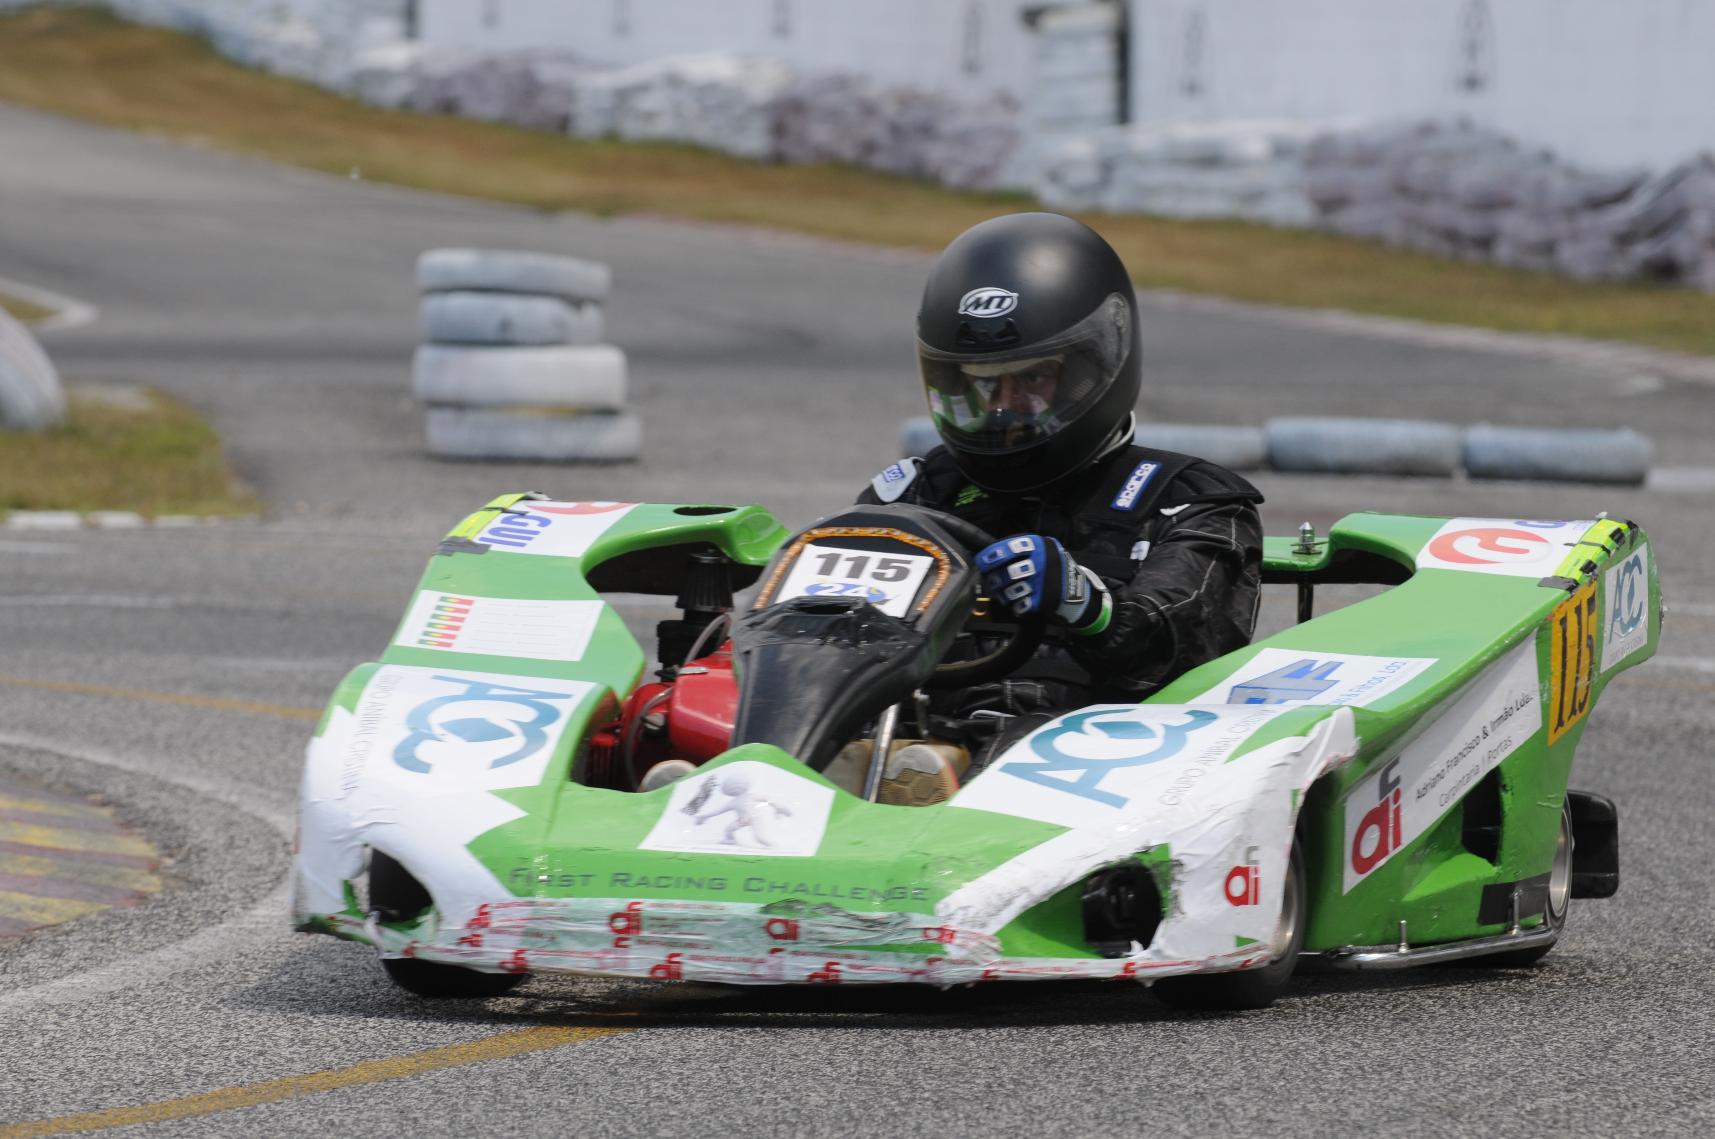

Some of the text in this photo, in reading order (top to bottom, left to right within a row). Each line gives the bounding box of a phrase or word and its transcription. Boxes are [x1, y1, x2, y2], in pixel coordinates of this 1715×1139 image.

[815, 552, 912, 582] 115
[1553, 591, 1596, 734] 115
[608, 872, 728, 891] RACING
[743, 877, 930, 901] CHALLENGE
